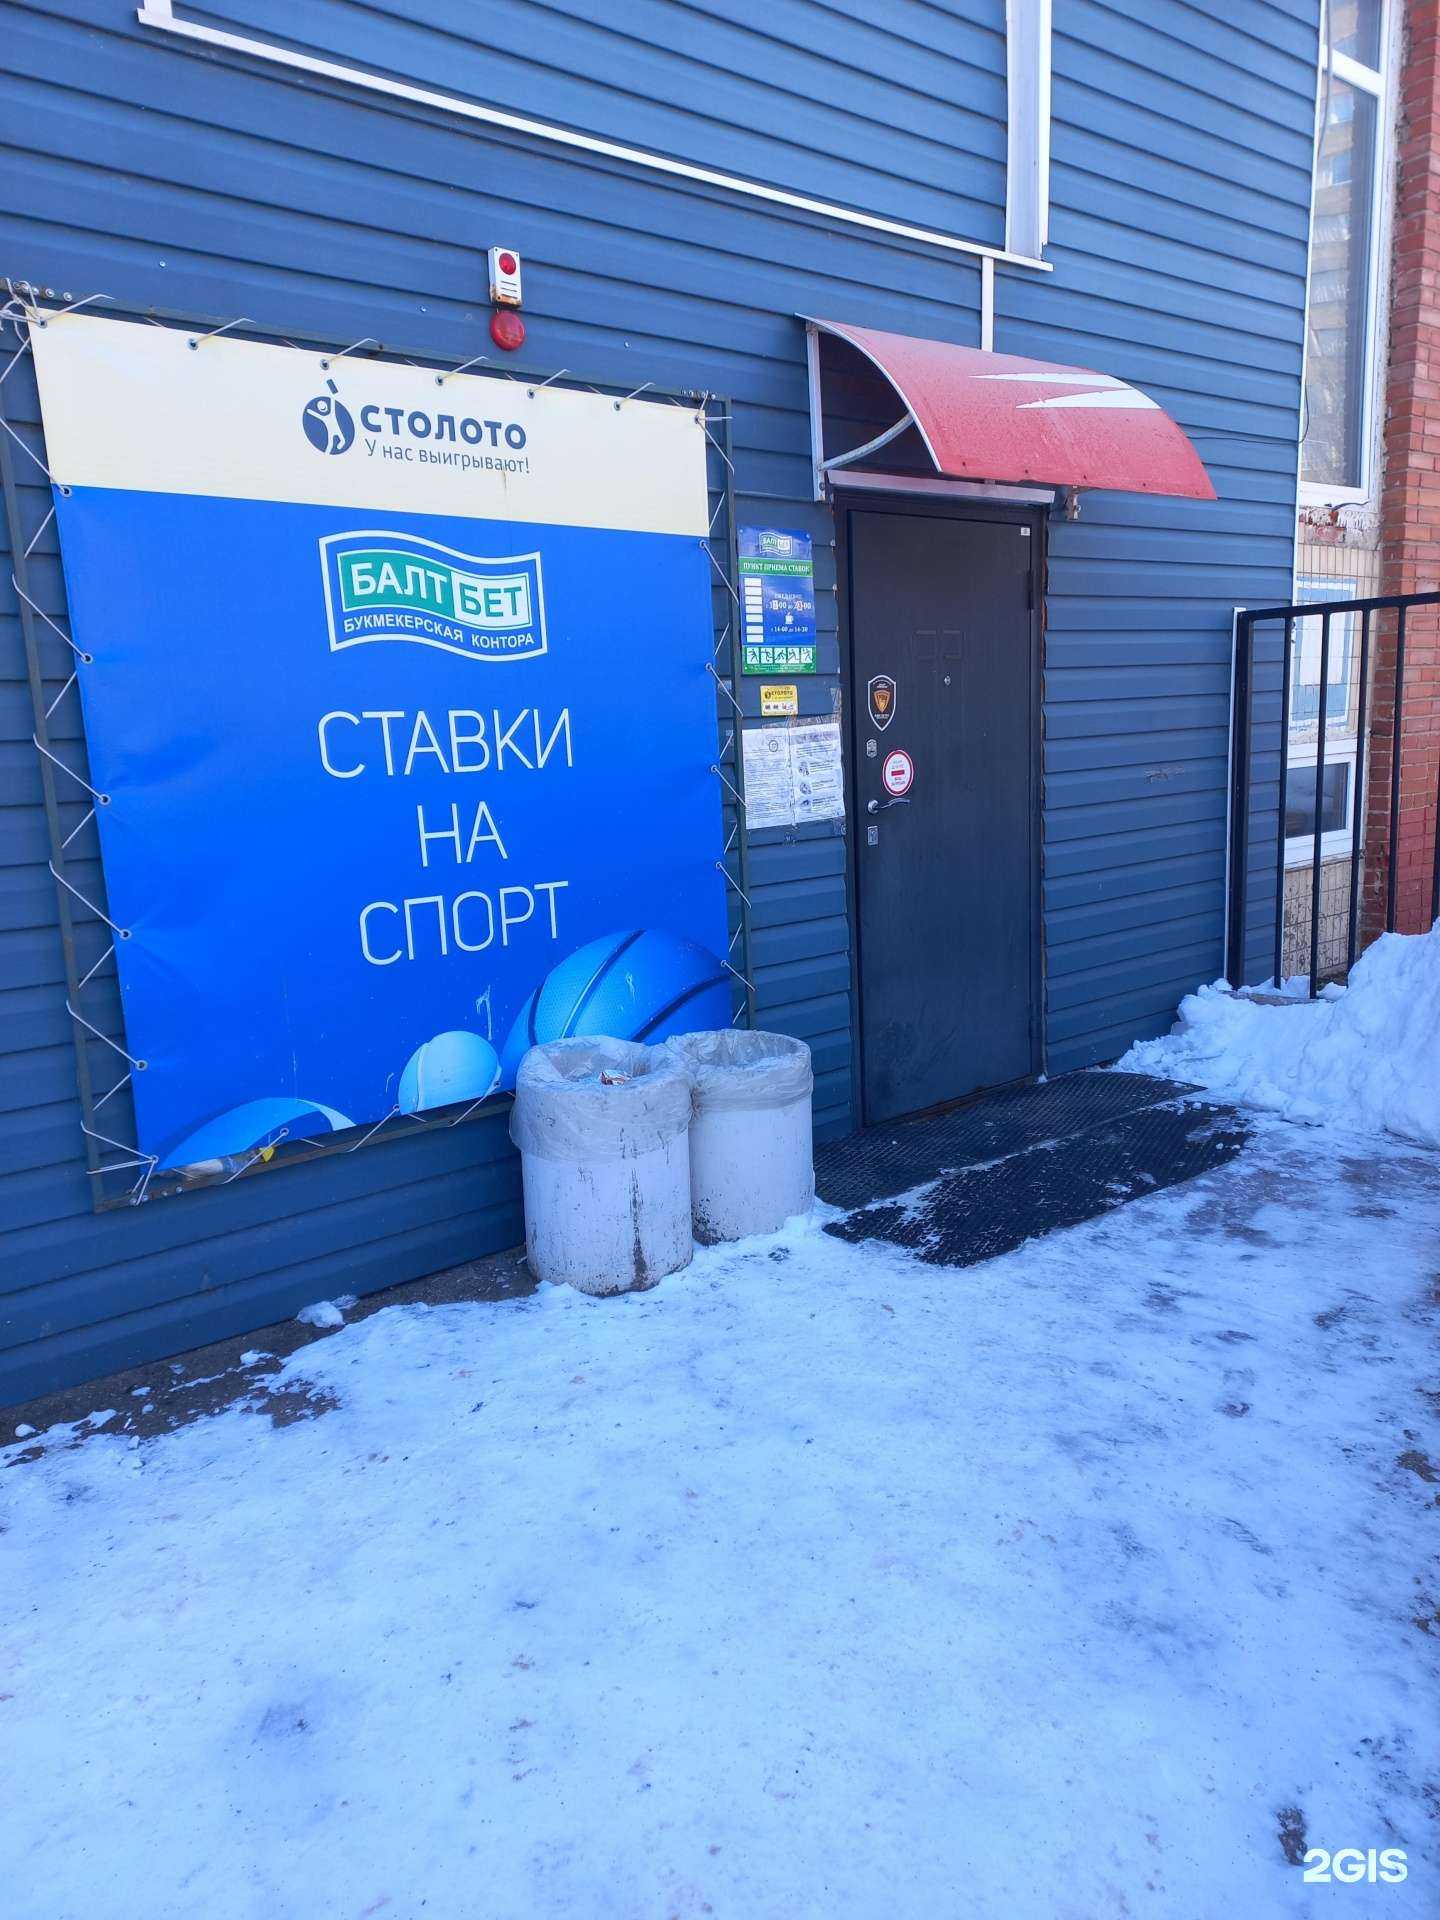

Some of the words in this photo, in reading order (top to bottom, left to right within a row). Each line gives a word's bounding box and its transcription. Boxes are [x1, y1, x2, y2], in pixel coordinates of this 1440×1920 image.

[360, 404, 527, 450] СТОЛОТО
[365, 438, 377, 457] У
[383, 445, 414, 462] нас
[419, 449, 530, 474] выигрывают!
[343, 613, 464, 643] БУКМЕКЕРСКАЯ
[471, 632, 535, 649] КОНТОРА
[318, 707, 573, 779] СТАВКИ
[416, 800, 509, 868] НА
[358, 880, 569, 966] СПОРТ
